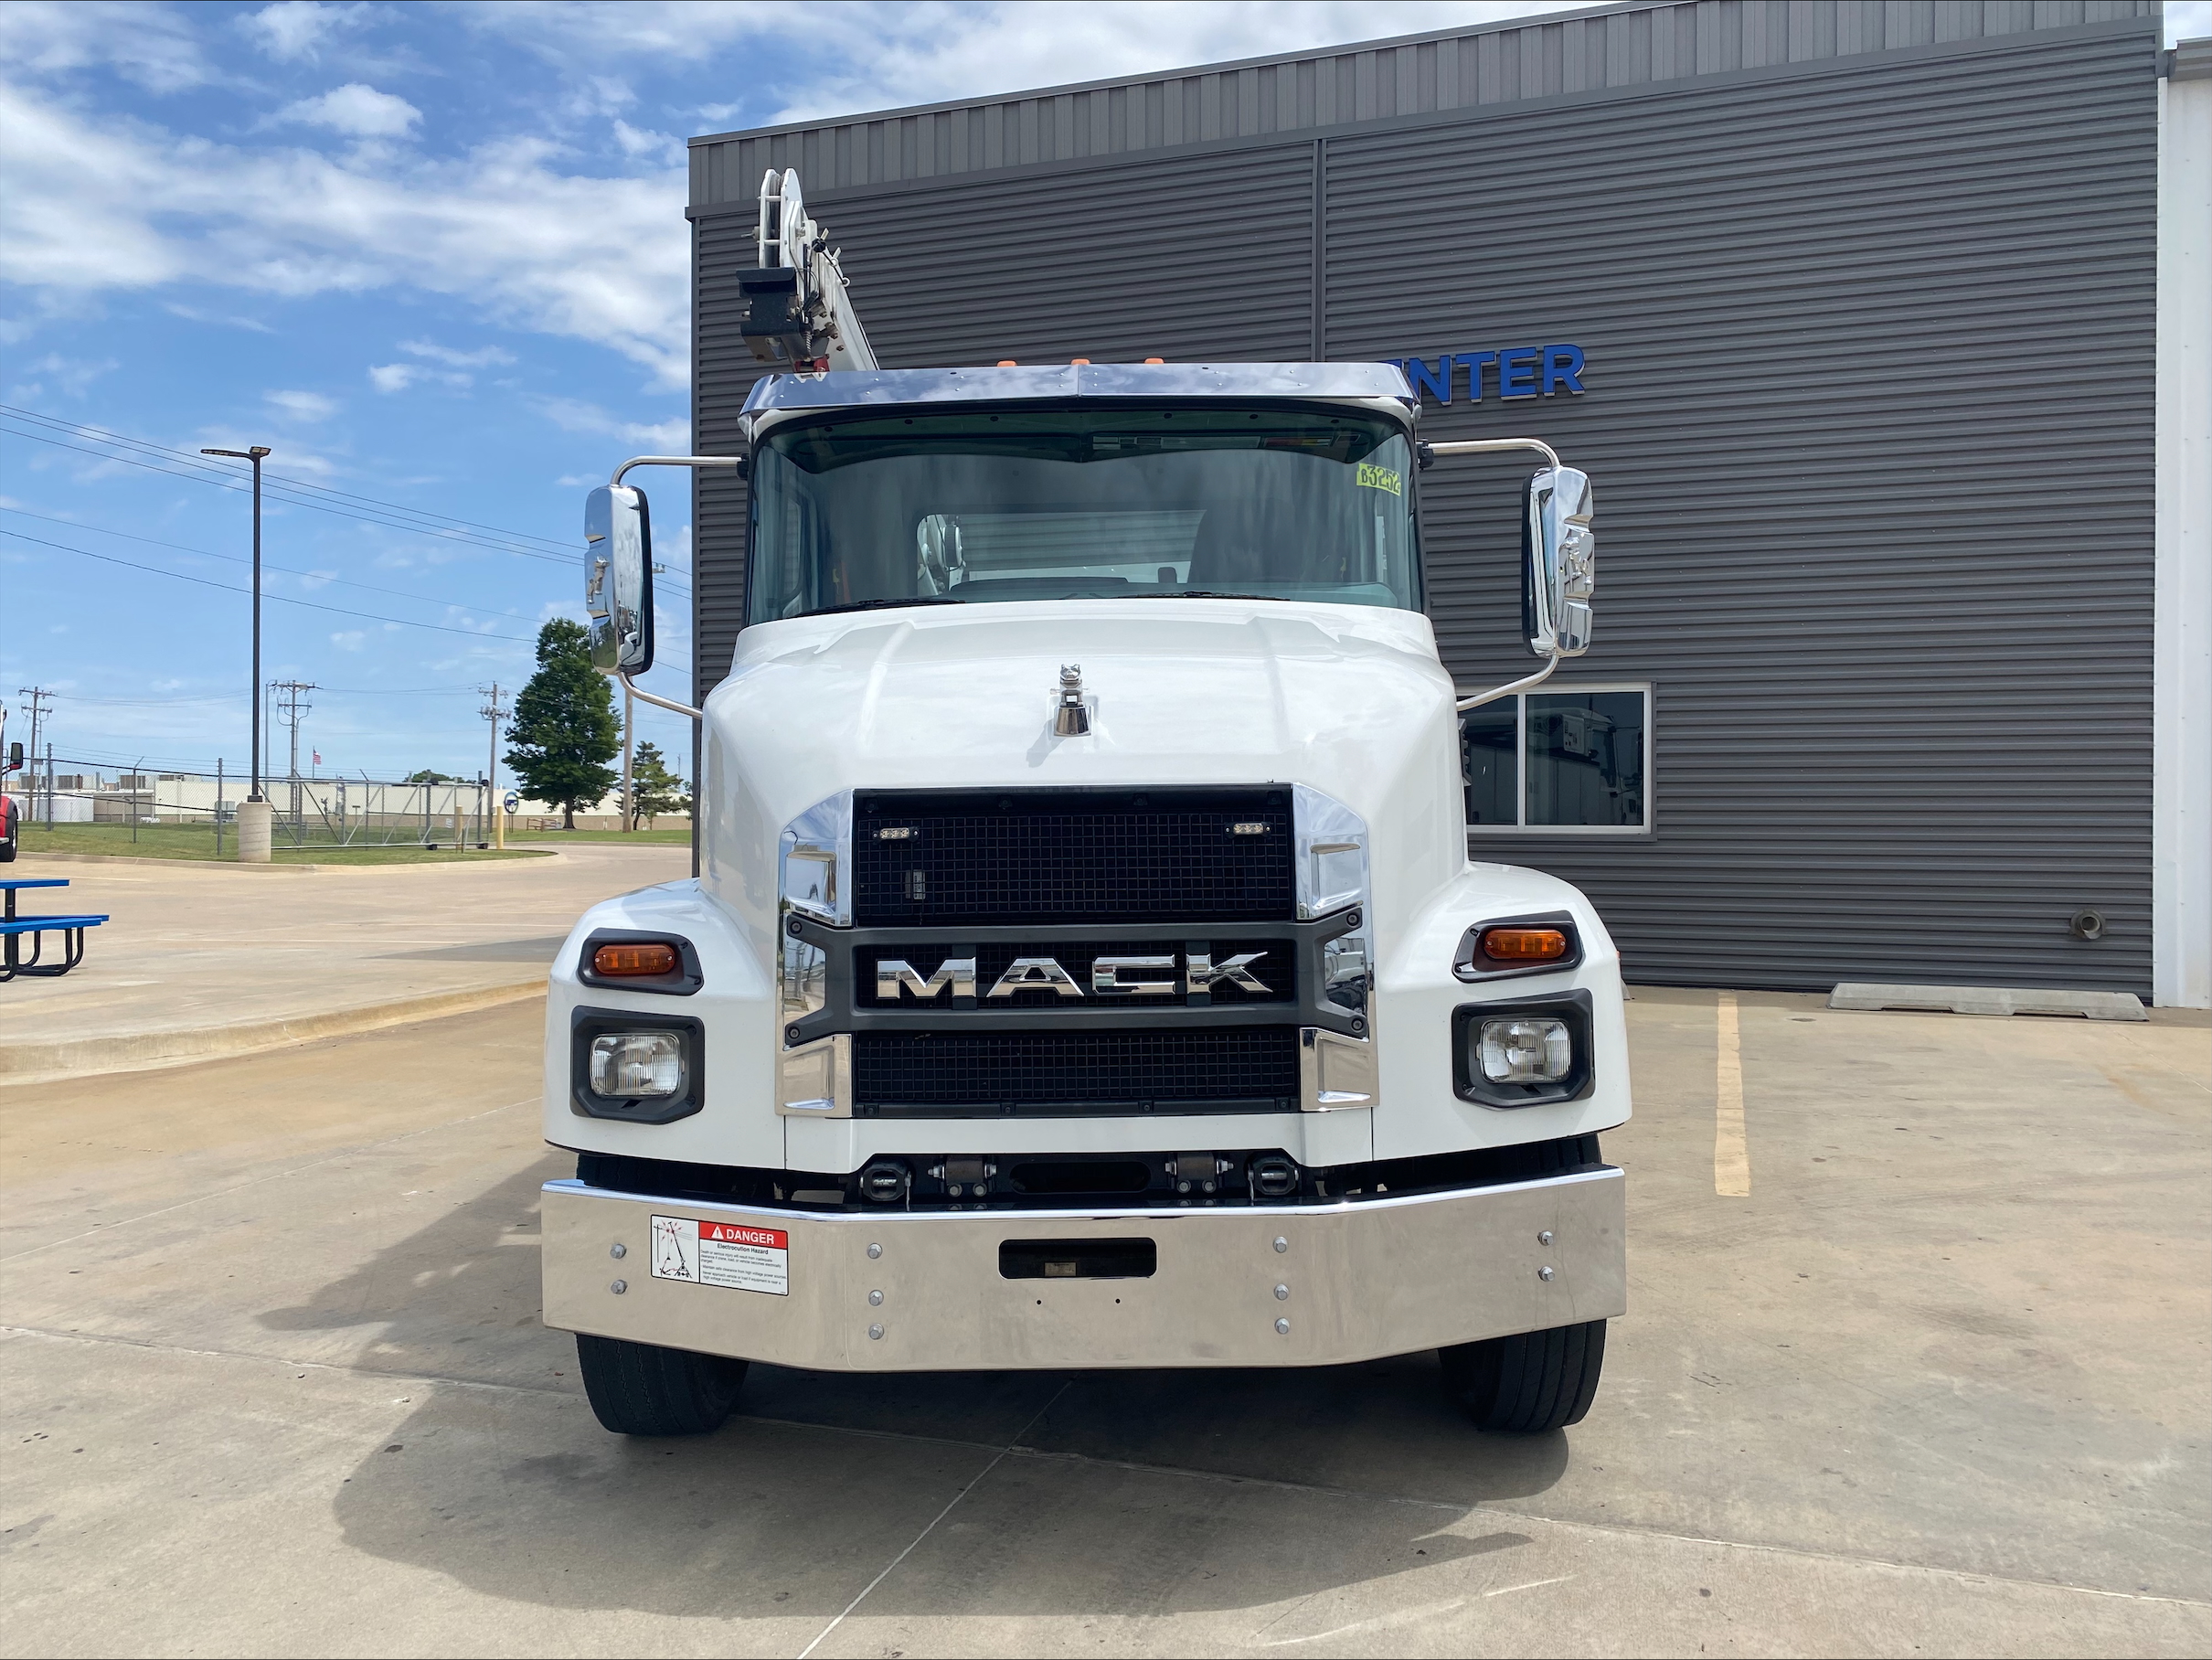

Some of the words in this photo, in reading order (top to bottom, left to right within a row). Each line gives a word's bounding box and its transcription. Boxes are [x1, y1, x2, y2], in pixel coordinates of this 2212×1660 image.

[1376, 344, 1585, 405] NTER
[876, 951, 1273, 999] MACK
[717, 1243, 750, 1252] Electrocution
[750, 1247, 769, 1255] Hazard
[726, 1229, 774, 1244] DANGER
